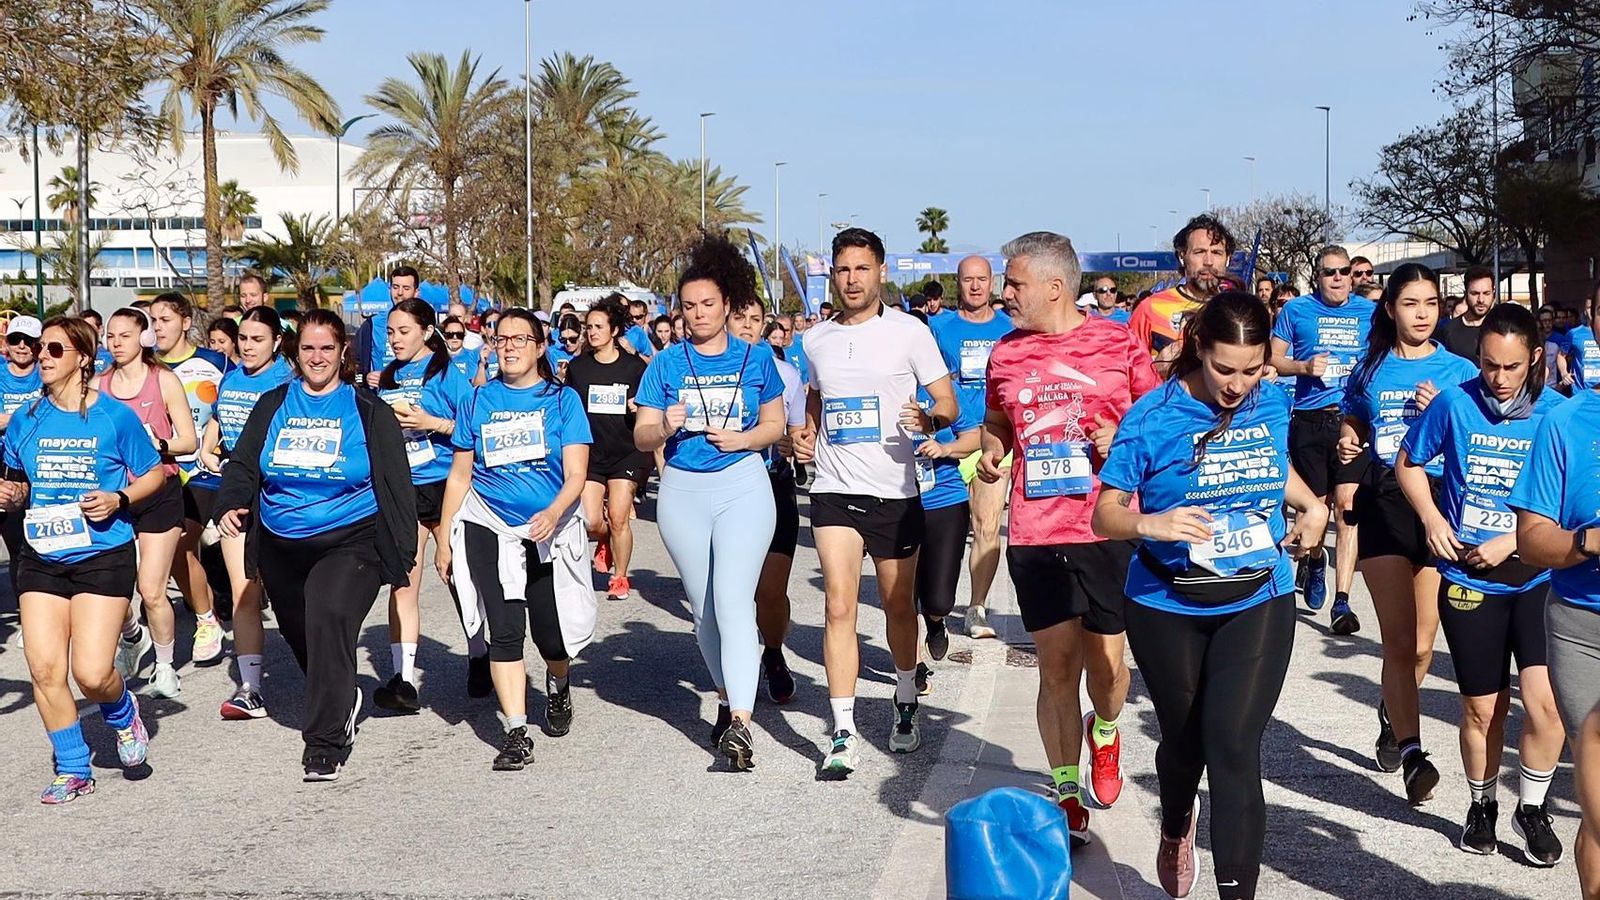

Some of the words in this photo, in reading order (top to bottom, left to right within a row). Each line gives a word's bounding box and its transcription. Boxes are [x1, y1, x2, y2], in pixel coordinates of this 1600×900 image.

[1318, 317, 1359, 325] mayoral
[963, 340, 996, 348] mayor
[684, 371, 741, 386] mayoral
[222, 390, 260, 401] mayoral
[1037, 392, 1069, 403] MÁLAGA
[491, 408, 545, 421] mayoral
[836, 411, 863, 426] 653
[287, 417, 341, 429] mayoral
[38, 436, 98, 450] mayoral
[288, 437, 328, 452] 2976
[495, 431, 533, 449] 2623
[1041, 459, 1071, 476] 978
[1480, 511, 1514, 529] 223
[35, 520, 74, 537] 2768
[1214, 530, 1253, 553] 546
